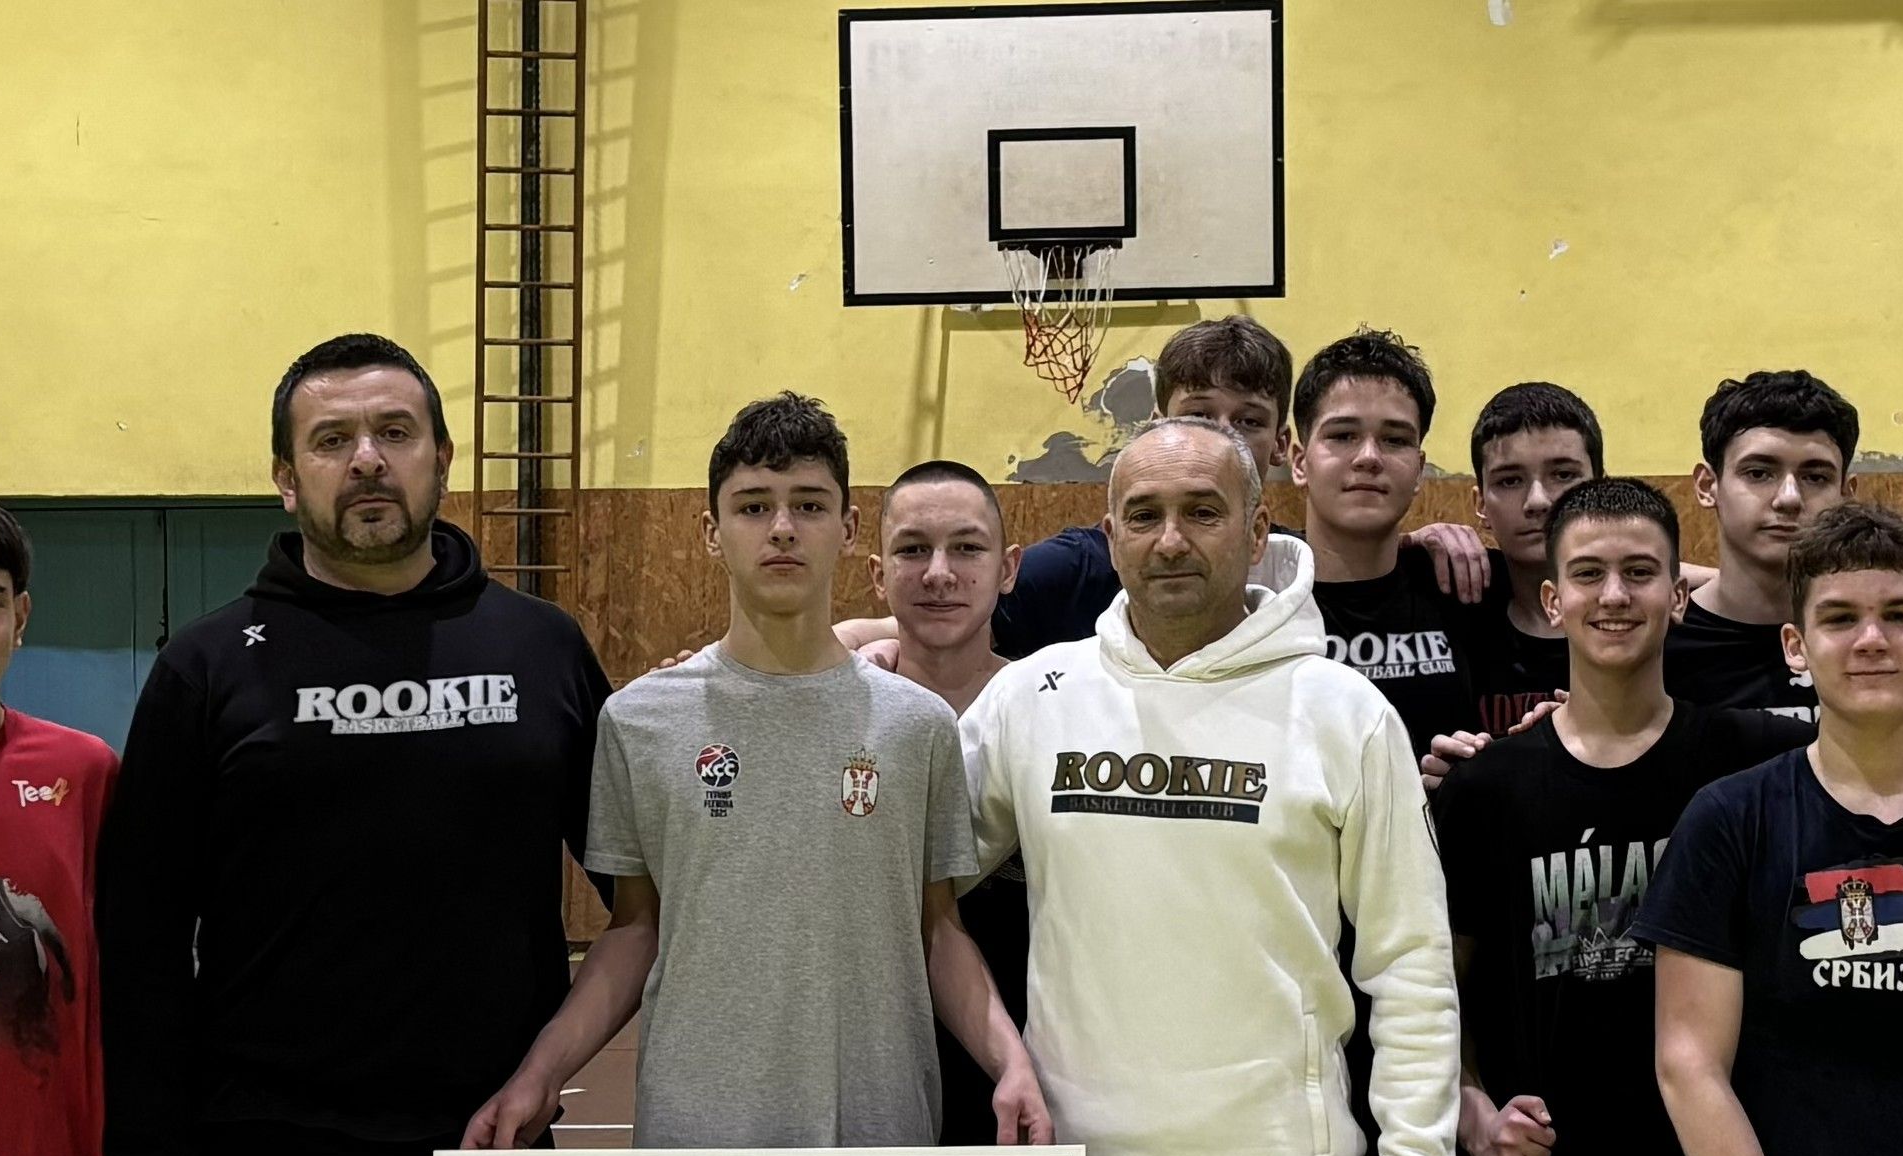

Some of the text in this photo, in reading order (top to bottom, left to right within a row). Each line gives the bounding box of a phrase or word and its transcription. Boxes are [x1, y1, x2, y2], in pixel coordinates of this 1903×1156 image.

[1326, 630, 1453, 666] OOKIE
[1350, 659, 1455, 680] TBALL CLUB
[294, 674, 518, 722] ROOKIE
[330, 706, 518, 734] BASKETBALL CLUB
[701, 763, 736, 778] KCC
[1051, 751, 1268, 802] ROOKIE
